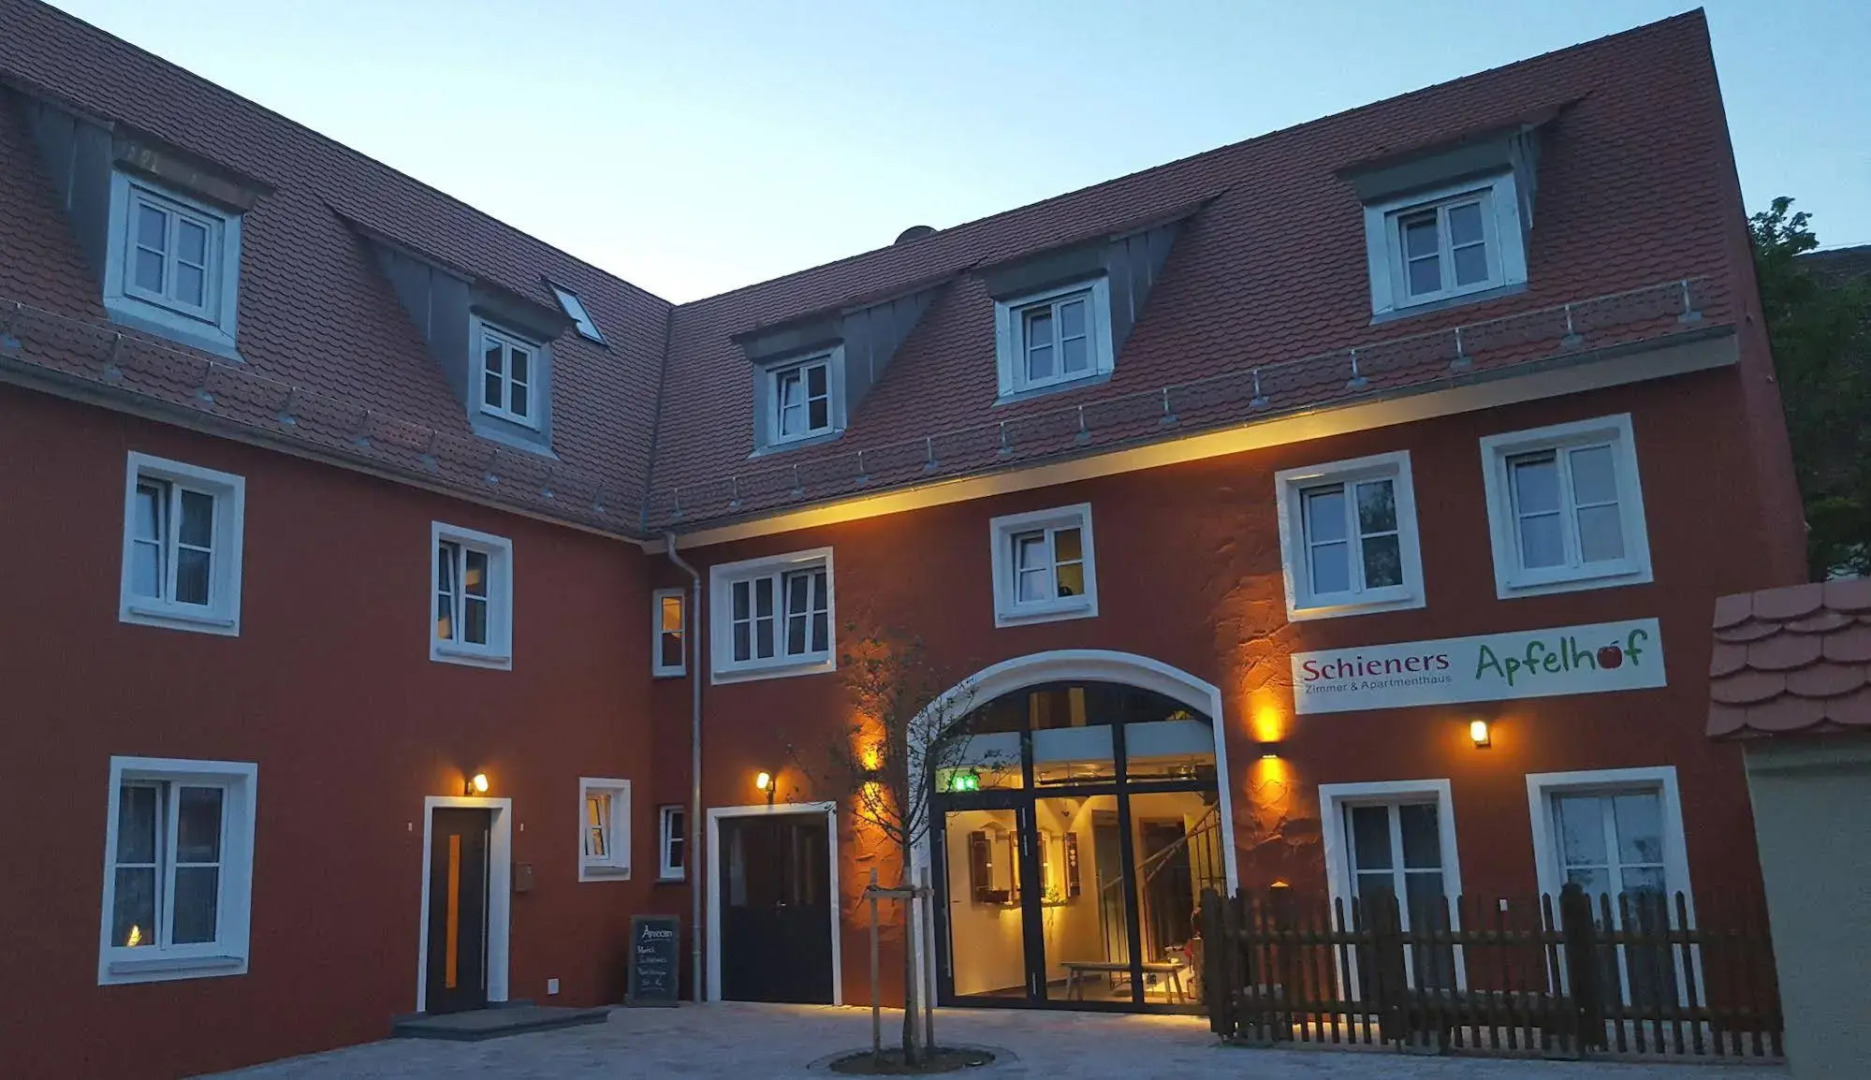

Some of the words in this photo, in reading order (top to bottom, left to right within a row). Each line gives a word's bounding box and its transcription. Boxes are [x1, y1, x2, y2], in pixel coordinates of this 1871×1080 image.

[1302, 653, 1450, 682] Schieners
[1475, 628, 1648, 687] Apfelhof
[1305, 683, 1348, 694] Zimmer
[1350, 681, 1358, 691] &
[1361, 675, 1453, 690] Apartmenthaus
